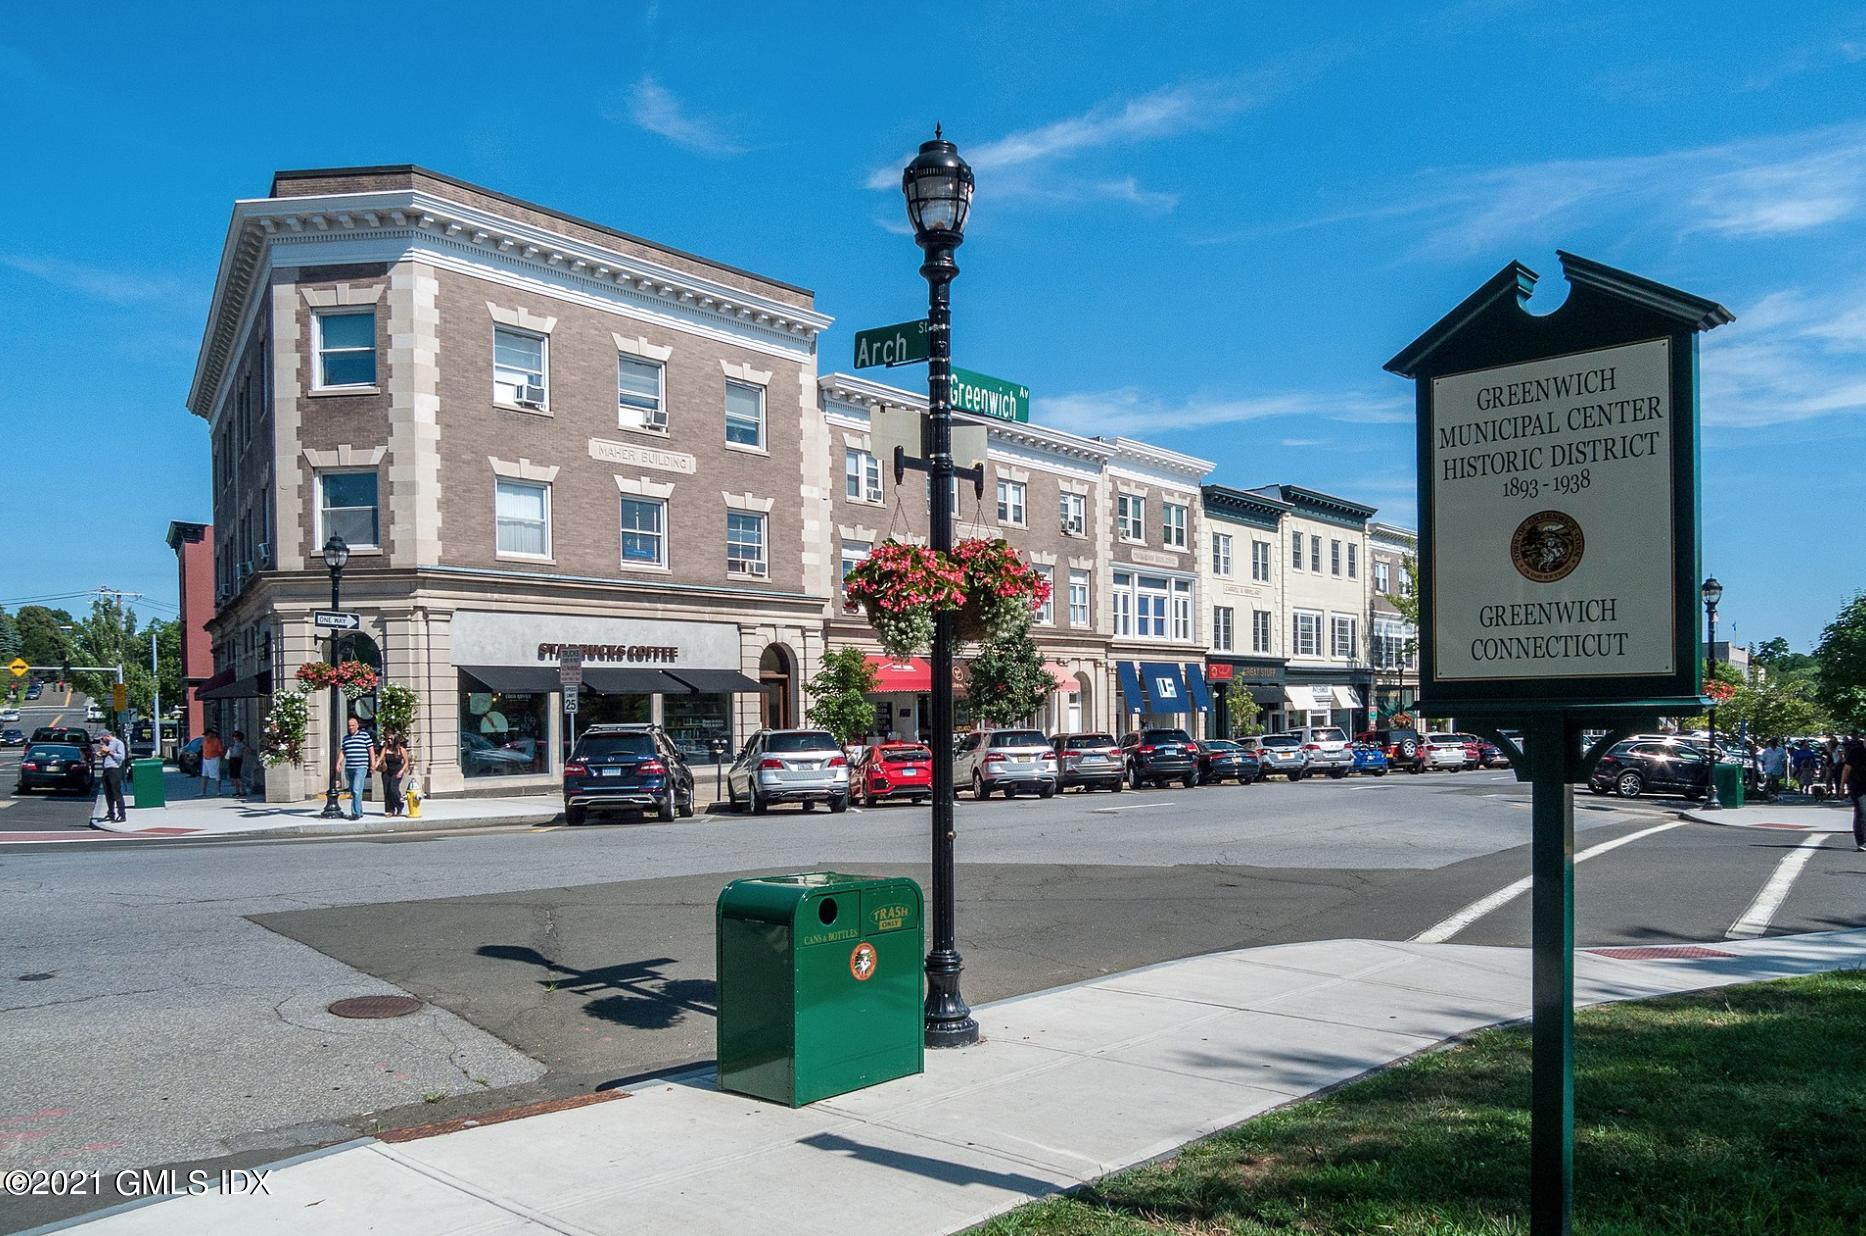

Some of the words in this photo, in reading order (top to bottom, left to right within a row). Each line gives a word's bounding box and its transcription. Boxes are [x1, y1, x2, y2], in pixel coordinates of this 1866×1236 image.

[856, 333, 907, 369] Arch
[918, 321, 928, 334] St
[950, 373, 1017, 420] Greenwich
[1019, 386, 1029, 399] Av
[1476, 366, 1617, 411] GREENWICH
[1439, 410, 1561, 450] MUNICIPAL
[1567, 395, 1664, 432] CENTER
[599, 445, 635, 461] MAHER
[641, 453, 687, 469] BUILDING
[1442, 446, 1543, 481] HISTORIC
[1550, 431, 1660, 468] DISTRICT
[1503, 477, 1539, 500] 1893
[1554, 469, 1591, 495] 1938
[320, 616, 332, 624] ONE
[1479, 598, 1618, 629] GREENWICH
[628, 645, 679, 661] COFFEE
[1470, 633, 1629, 662] CONNECTICUT
[566, 699, 577, 711] 25
[874, 906, 908, 920] TRASH
